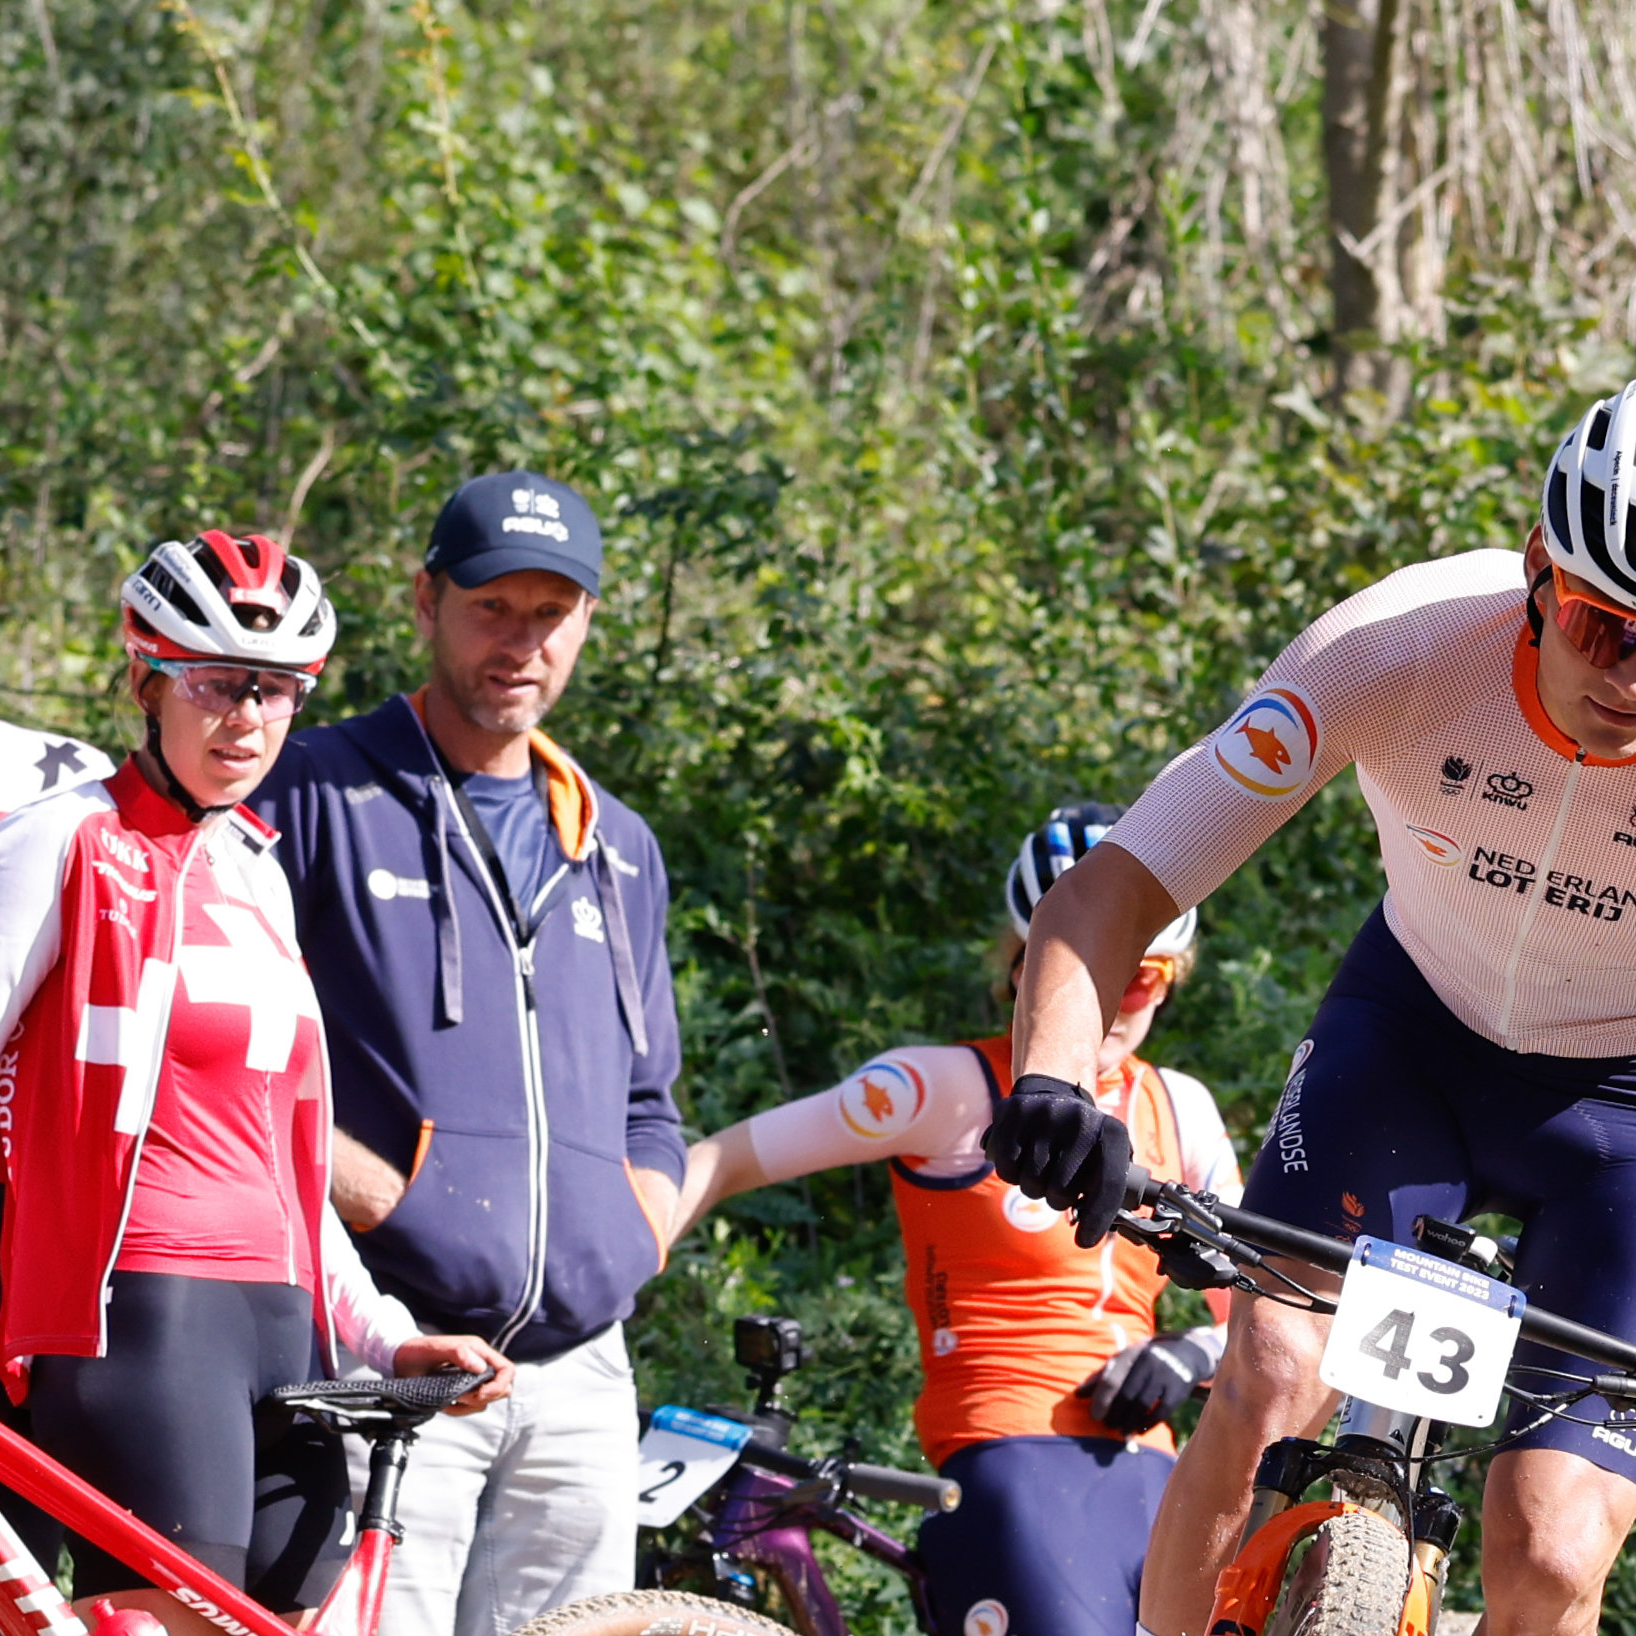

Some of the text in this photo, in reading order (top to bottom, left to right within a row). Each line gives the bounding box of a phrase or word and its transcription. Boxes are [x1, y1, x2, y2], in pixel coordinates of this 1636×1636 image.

[1426, 1228, 1467, 1249] wahoo
[1390, 1258, 1490, 1300] TEST EVENT 2023
[1394, 1248, 1490, 1290] MOUNTAIN BIKE
[1358, 1308, 1476, 1395] 43
